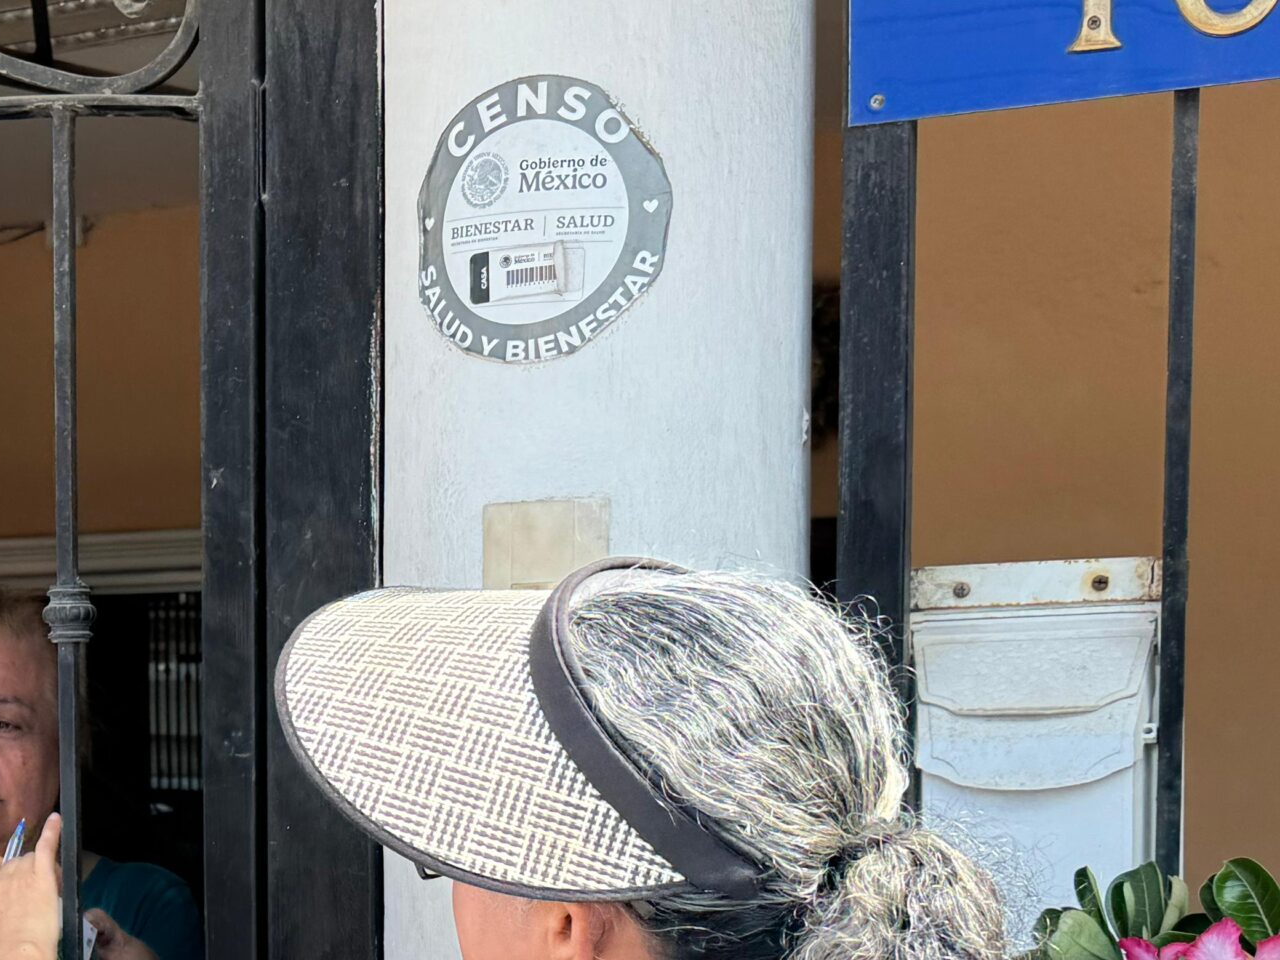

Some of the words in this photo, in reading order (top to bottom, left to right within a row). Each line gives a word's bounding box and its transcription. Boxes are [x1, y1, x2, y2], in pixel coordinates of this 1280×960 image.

[447, 81, 630, 157] CENSO
[519, 157, 586, 171] Gobierno
[590, 154, 608, 167] de
[518, 168, 608, 194] México
[450, 218, 535, 240] BIENESTAR
[556, 214, 615, 229] SALUD
[480, 266, 488, 290] CASA
[420, 265, 473, 348] SALUD
[480, 335, 500, 357] Y
[505, 249, 660, 361] BIENESTAR
